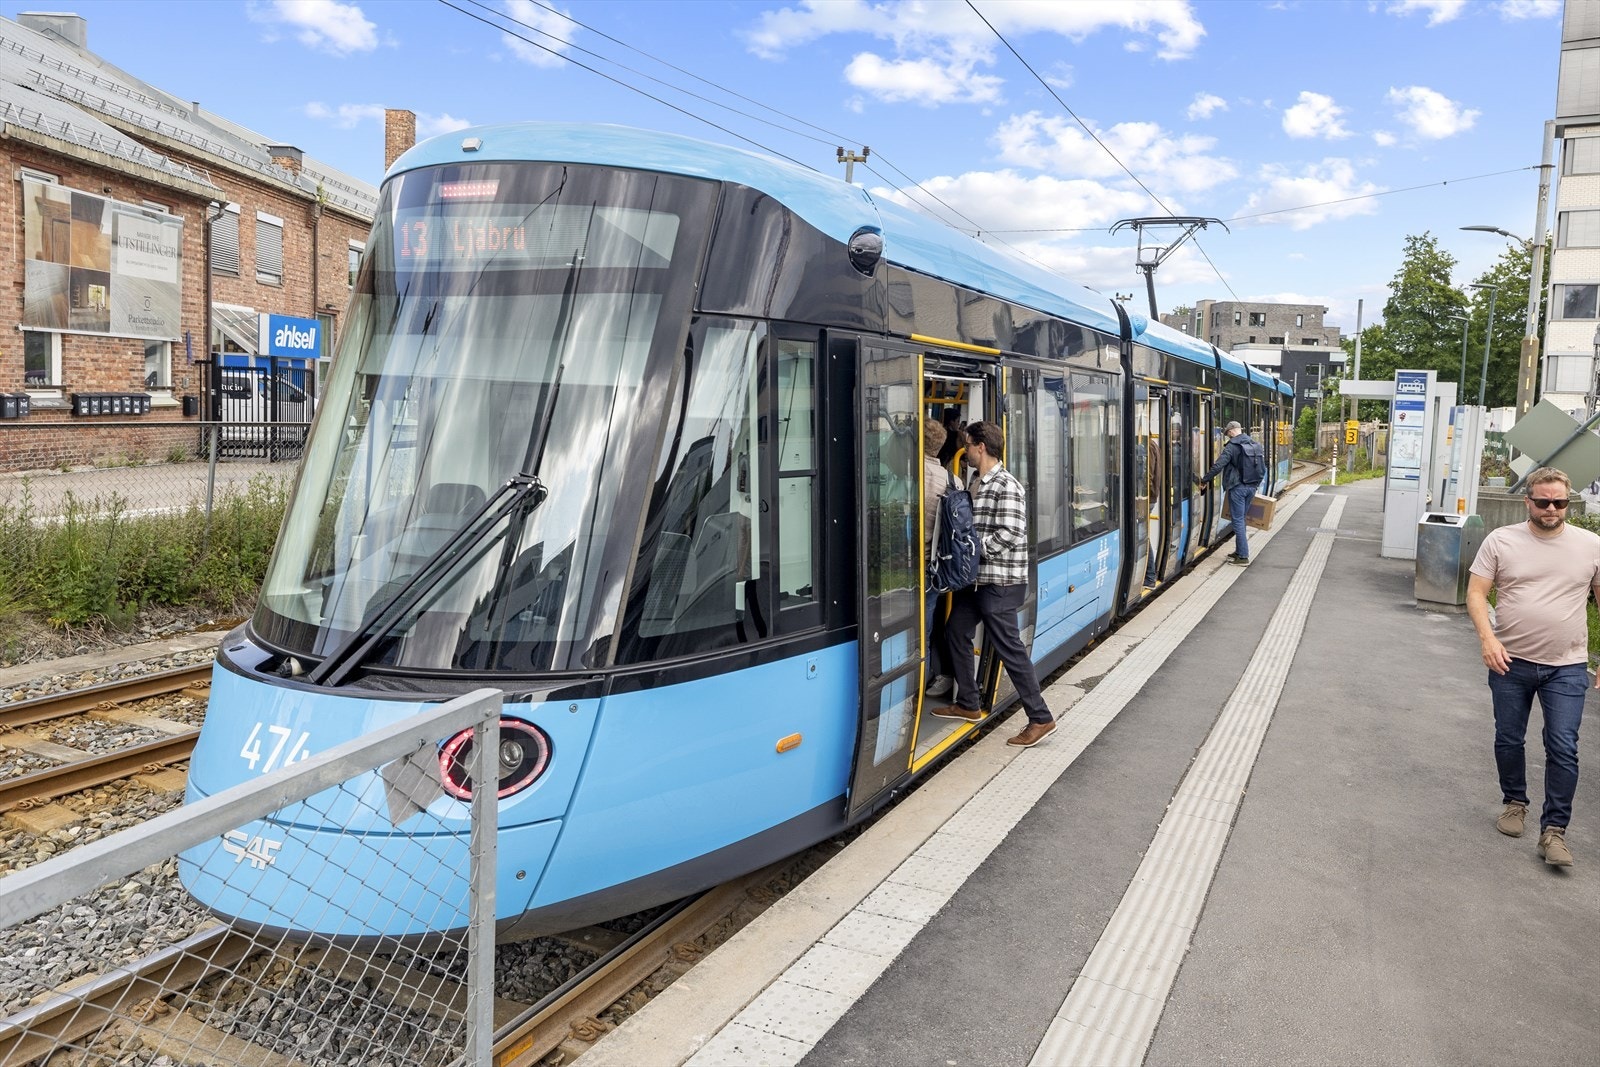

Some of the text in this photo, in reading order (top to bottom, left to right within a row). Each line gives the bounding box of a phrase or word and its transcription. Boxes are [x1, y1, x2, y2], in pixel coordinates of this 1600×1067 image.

[401, 219, 525, 259] 13 Ljabru
[274, 324, 317, 350] ahlsell
[1347, 431, 1355, 442] 3
